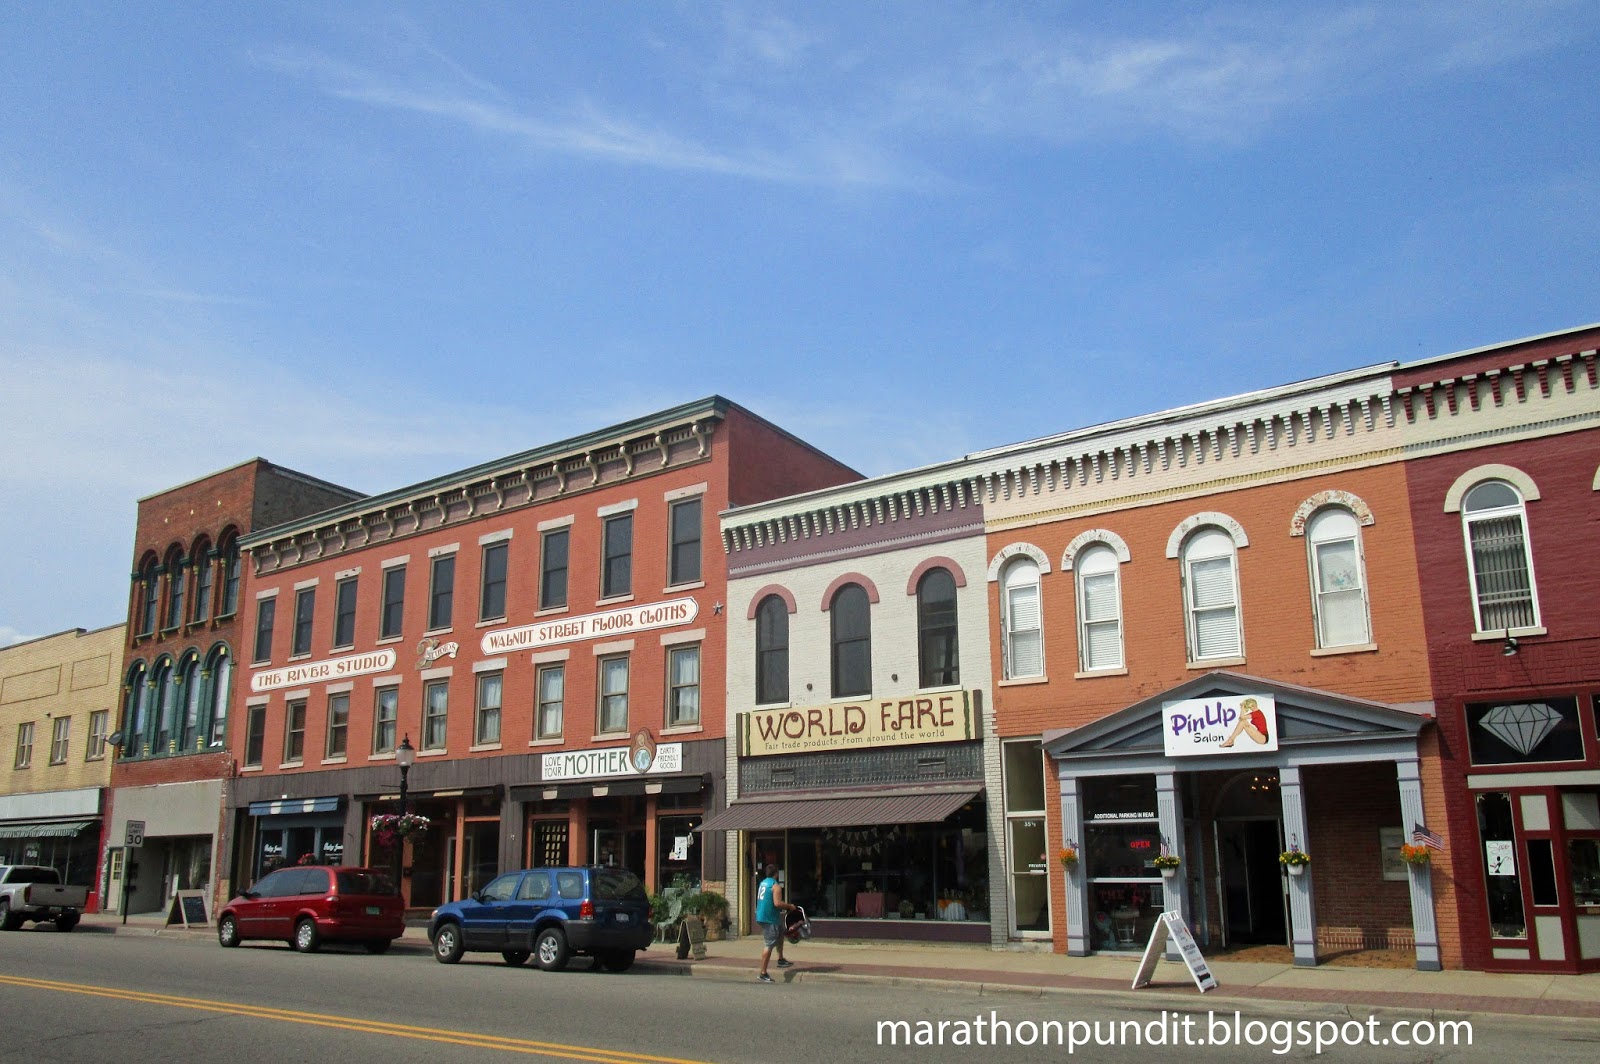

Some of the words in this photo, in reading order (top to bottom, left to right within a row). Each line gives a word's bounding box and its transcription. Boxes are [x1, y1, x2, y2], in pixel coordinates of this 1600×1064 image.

[490, 630, 534, 649] WALNUT
[539, 621, 586, 641] STREET
[592, 613, 633, 632] FLOOR
[639, 604, 687, 624] CLOTHS
[257, 675, 281, 687] THE
[287, 665, 329, 682] RIVER
[336, 654, 388, 673] STUDIO
[756, 706, 866, 741] WORLD
[881, 697, 954, 731] FARE
[765, 742, 778, 750] Fair
[781, 741, 801, 749] trade
[804, 737, 838, 749] products
[840, 736, 863, 746] from
[866, 733, 896, 742] around
[900, 731, 915, 739] the
[919, 729, 945, 738] world
[1193, 733, 1225, 743] Salon
[544, 756, 561, 767] LOVE
[564, 751, 628, 776] MOTHER
[544, 767, 562, 777] YOUR
[127, 834, 141, 844] 30
[1130, 840, 1150, 848] OPEN
